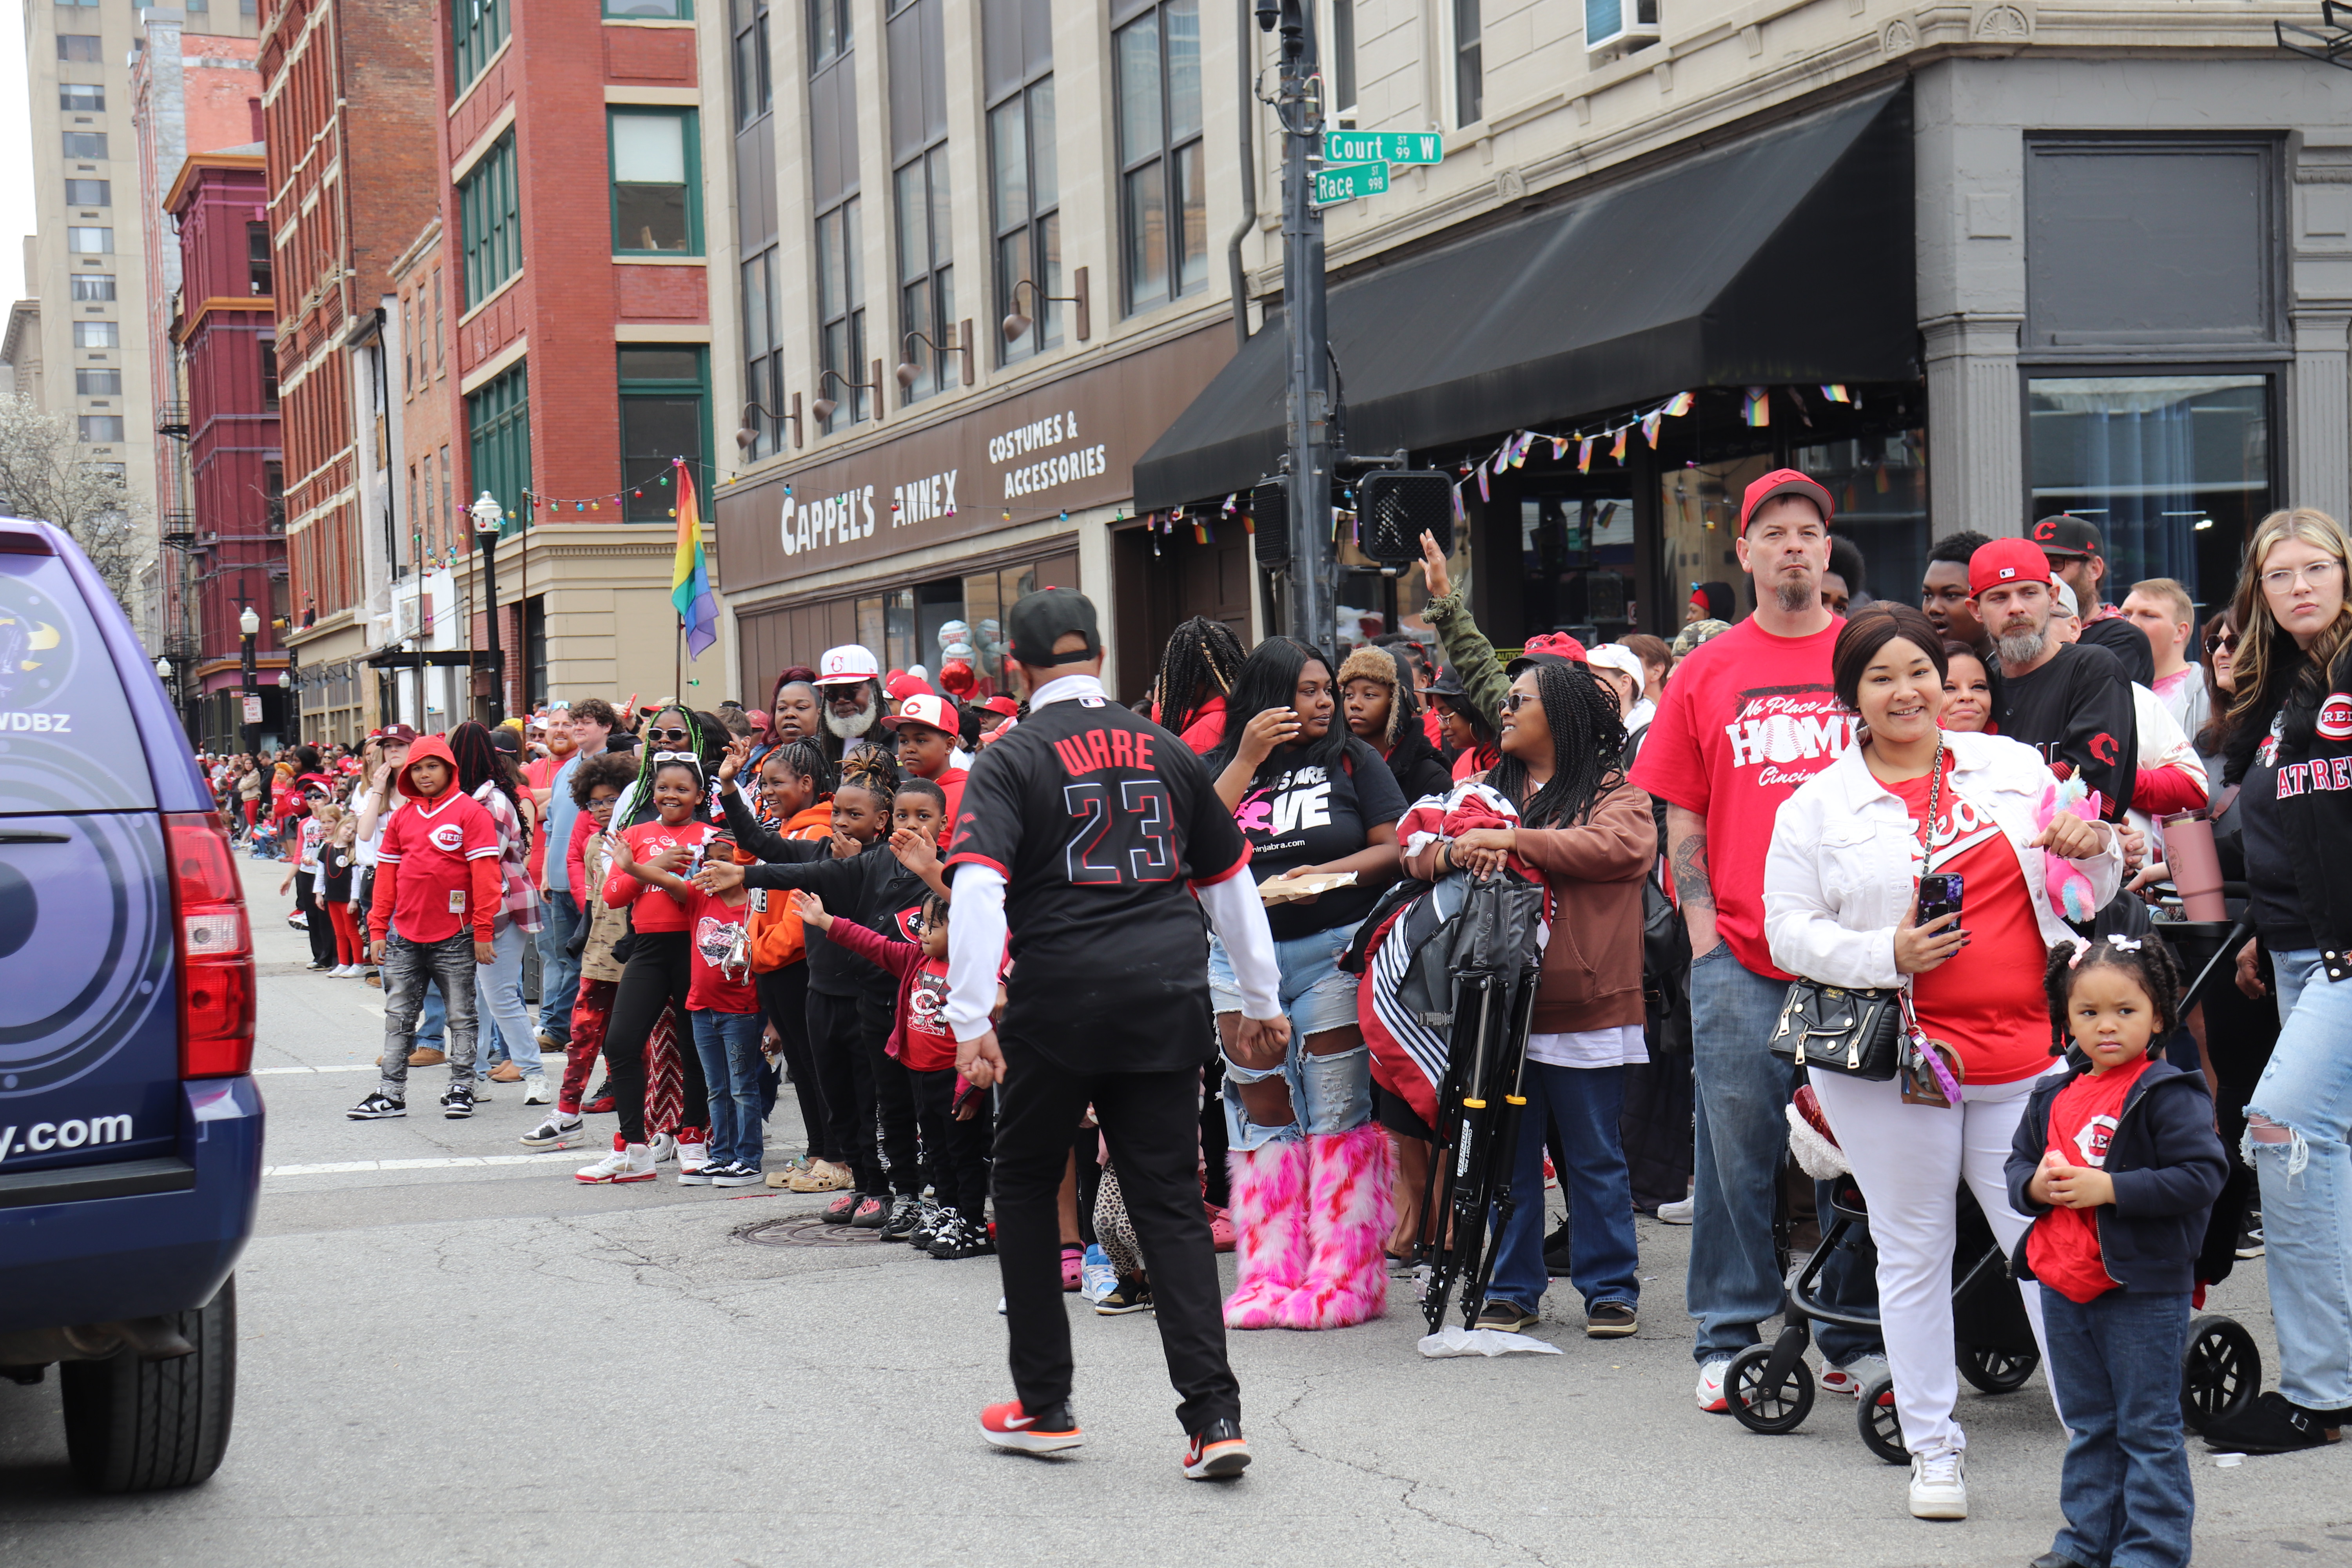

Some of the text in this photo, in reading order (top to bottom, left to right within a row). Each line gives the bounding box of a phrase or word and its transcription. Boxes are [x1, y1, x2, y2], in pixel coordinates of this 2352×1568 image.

[1331, 134, 1435, 160] Court ST W
[1395, 147, 1410, 159] 99
[1319, 175, 1383, 200] Race 998
[1371, 165, 1379, 176] ST
[989, 410, 1078, 465] COSTUMES &
[1004, 443, 1106, 500] ACCESSORIES
[892, 469, 958, 529] ANNEX
[1733, 699, 1767, 724] No
[1766, 697, 1822, 714] Place
[1054, 729, 1155, 777] WARE
[1290, 766, 1328, 787] ARE
[2308, 756, 2352, 791] RE
[1063, 780, 1180, 885] 23
[1457, 1126, 1467, 1170] ROCKER
